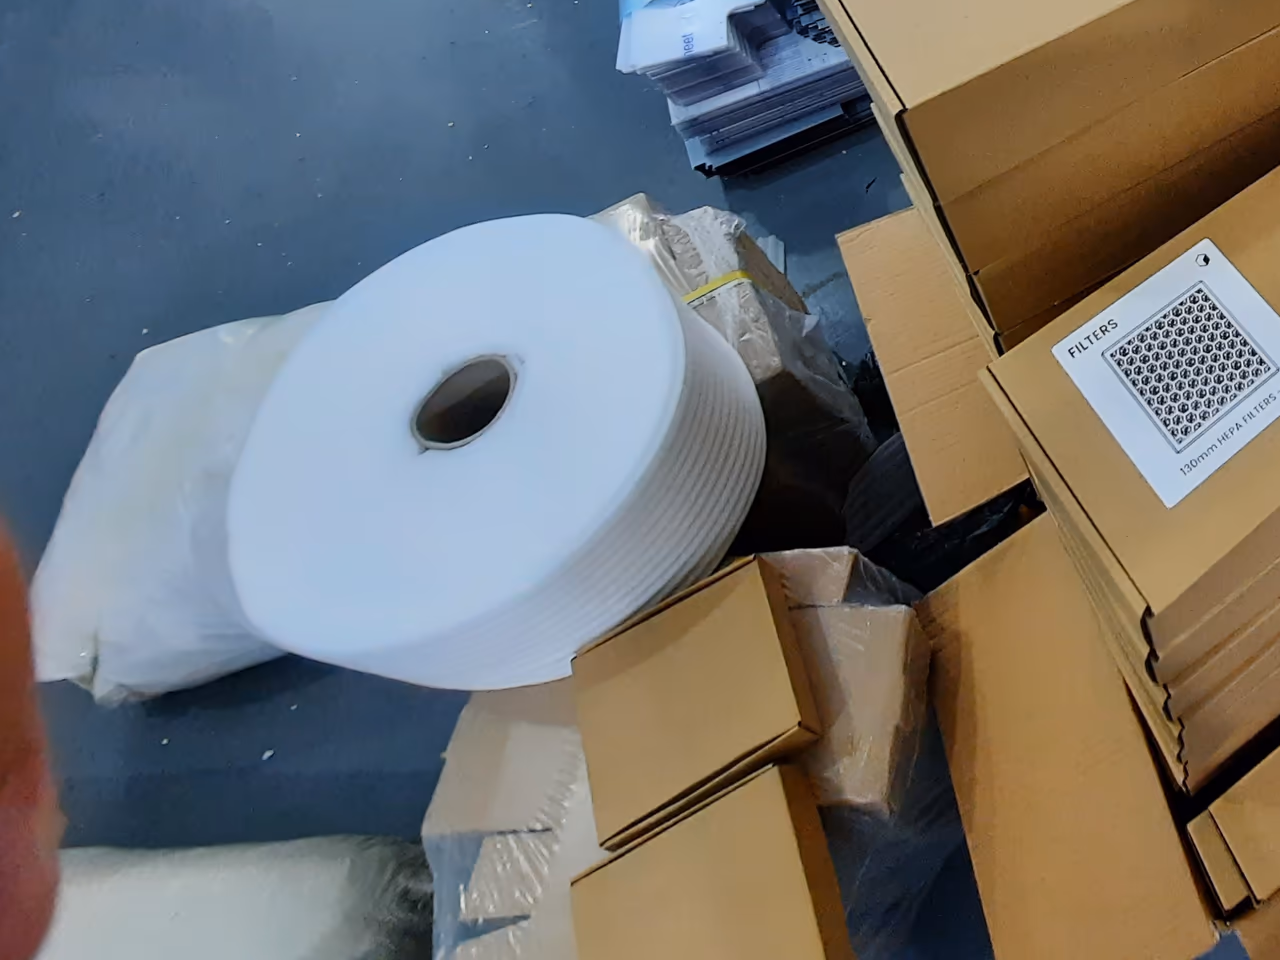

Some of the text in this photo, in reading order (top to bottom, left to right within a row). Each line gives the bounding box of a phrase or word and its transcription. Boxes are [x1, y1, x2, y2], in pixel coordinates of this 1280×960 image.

[1067, 318, 1120, 360] FILTERS
[1179, 442, 1219, 477] 130mm
[1216, 421, 1244, 446] HEPA
[1241, 392, 1278, 425] FILTERS
